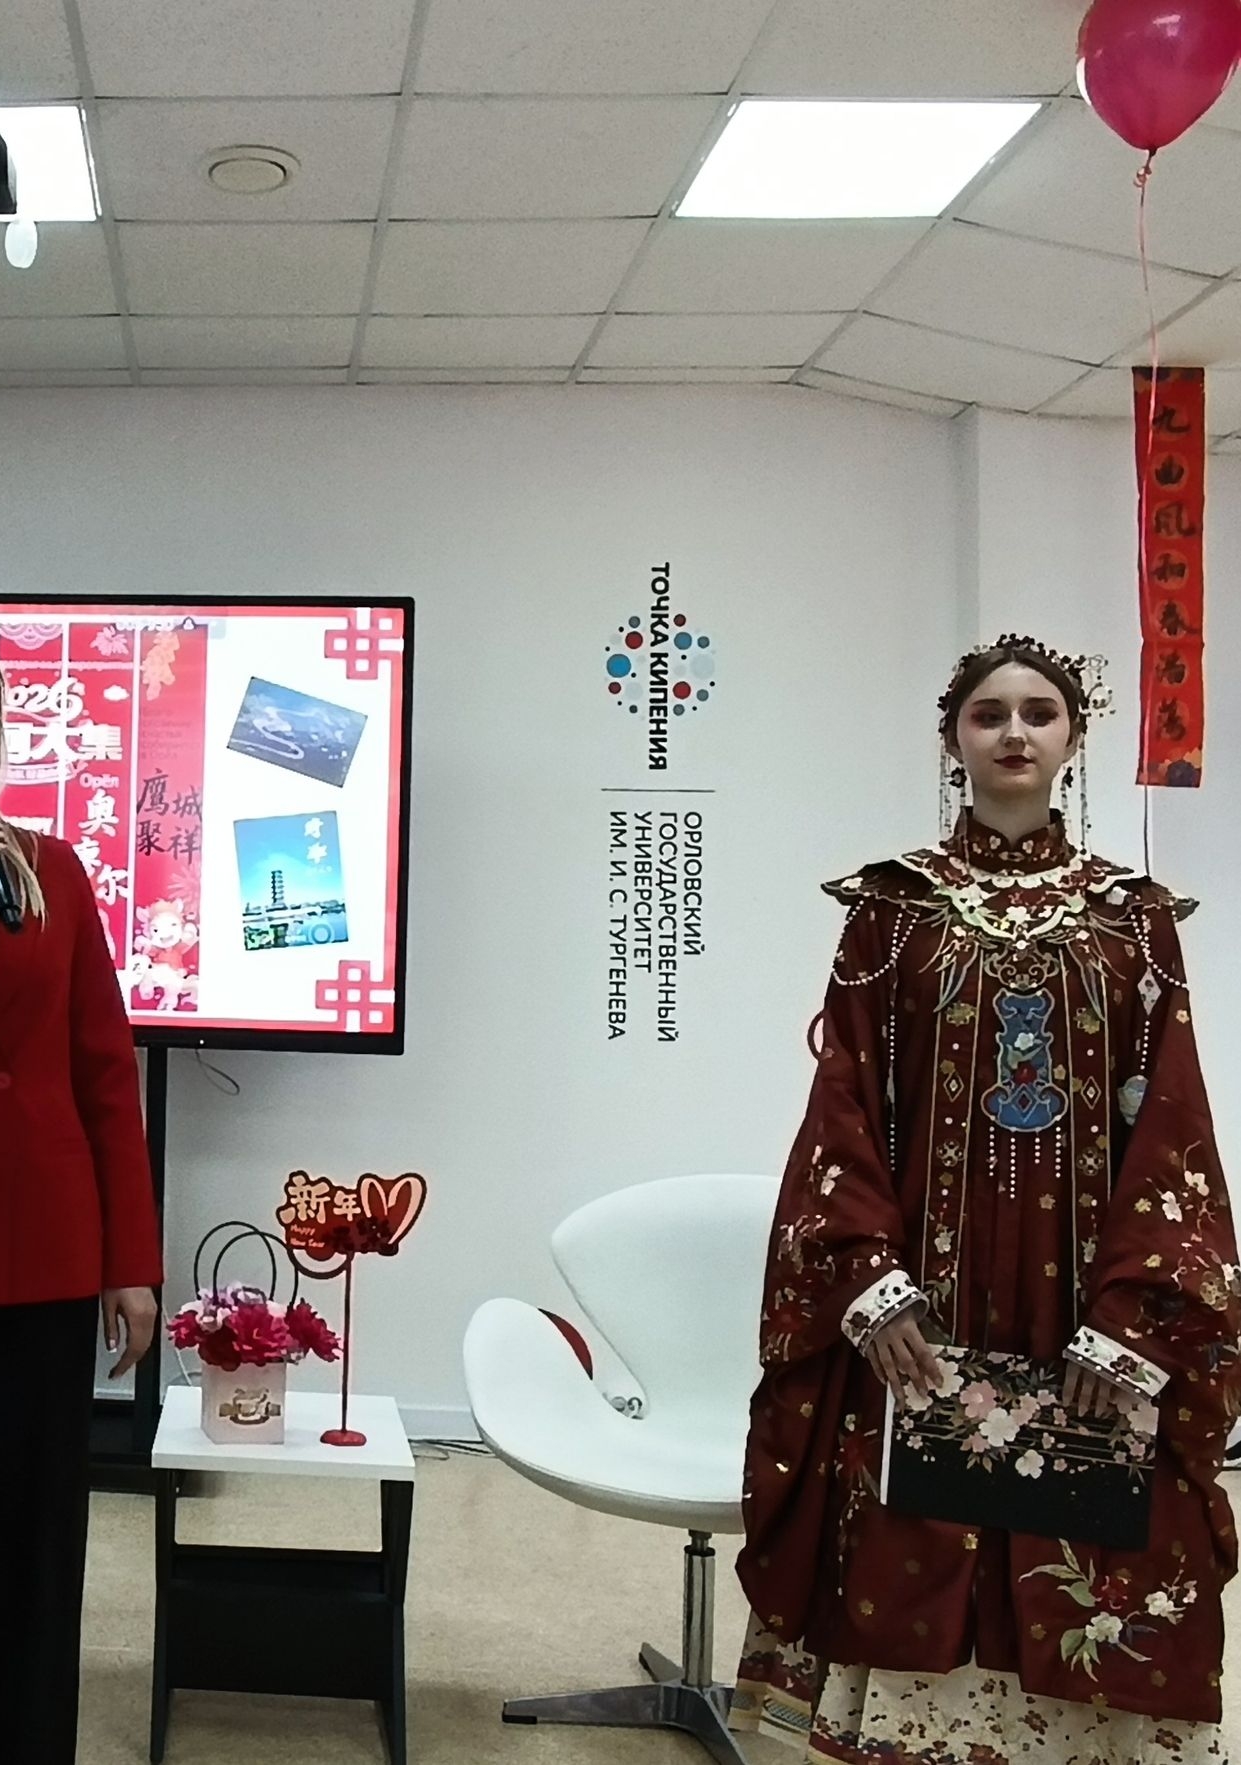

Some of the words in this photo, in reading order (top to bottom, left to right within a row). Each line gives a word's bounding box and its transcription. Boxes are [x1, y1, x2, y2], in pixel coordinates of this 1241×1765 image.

[650, 561, 670, 647] ТОЧКА
[6, 677, 84, 722] 026
[648, 652, 669, 770] КИПЕНИЯ
[137, 819, 201, 865] 聚祥
[609, 811, 627, 853] ИМ.
[609, 860, 627, 881] И.
[609, 889, 627, 908] С.
[633, 811, 653, 973] УНИВЕРСИТЕТ
[683, 811, 705, 955] ОРЛОВСКИЙ
[656, 811, 679, 1042] ГОСУДАРСТВЕННЫЙ
[608, 914, 627, 1040] ТУРГЕНЕВА
[279, 1174, 362, 1225] 新年
